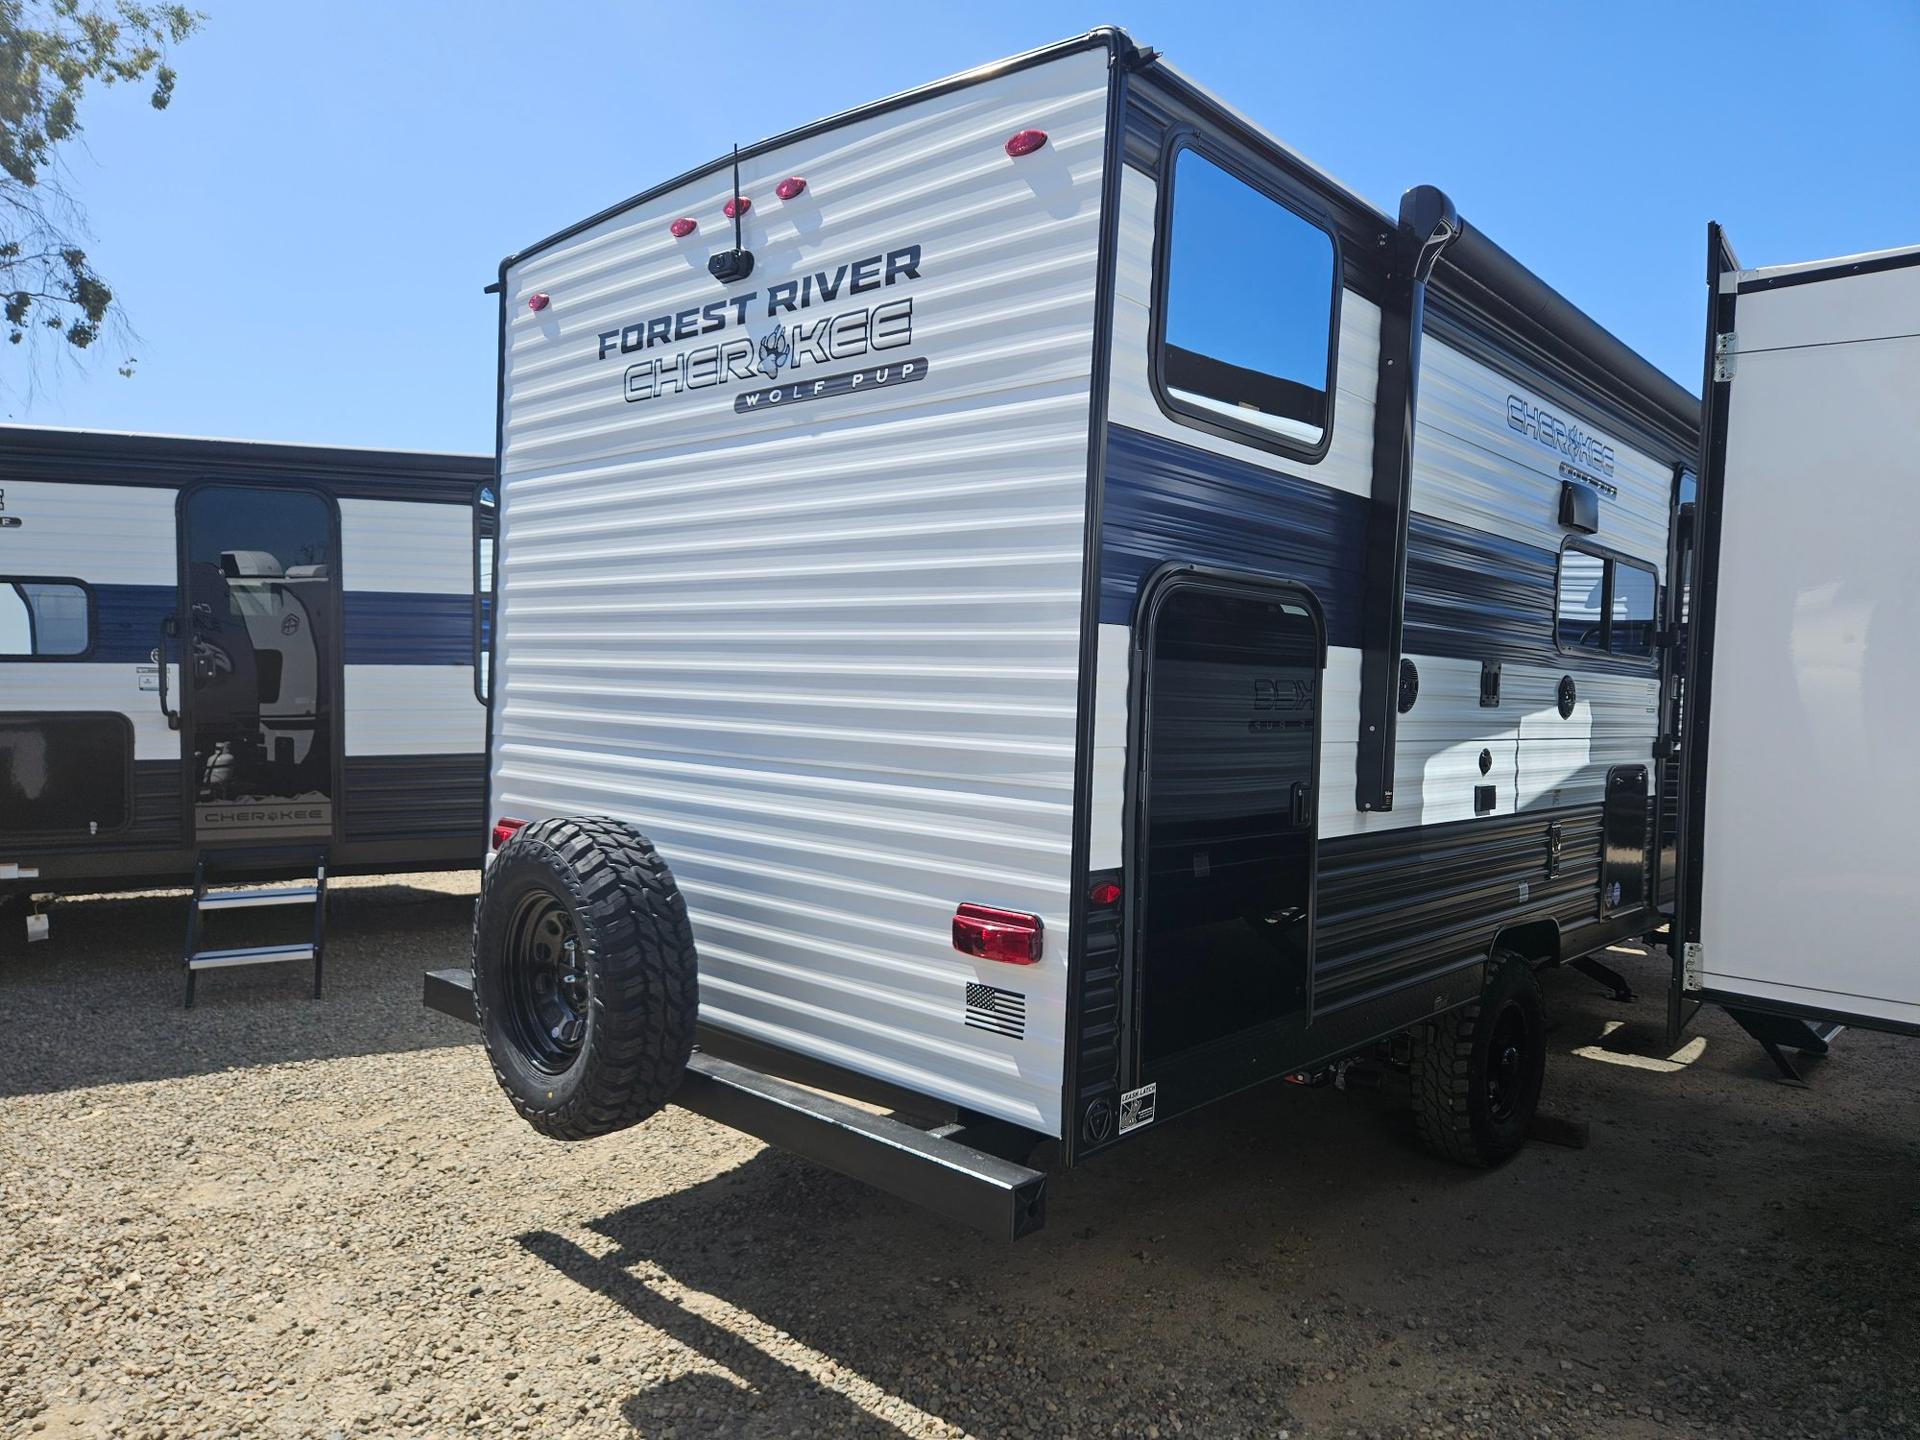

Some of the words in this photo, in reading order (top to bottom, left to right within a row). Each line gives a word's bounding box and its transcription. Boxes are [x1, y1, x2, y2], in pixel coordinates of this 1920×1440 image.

[598, 290, 757, 360] FOREST
[767, 244, 922, 317] RIVER
[745, 380, 826, 407] WOLF
[852, 363, 915, 388] PUP
